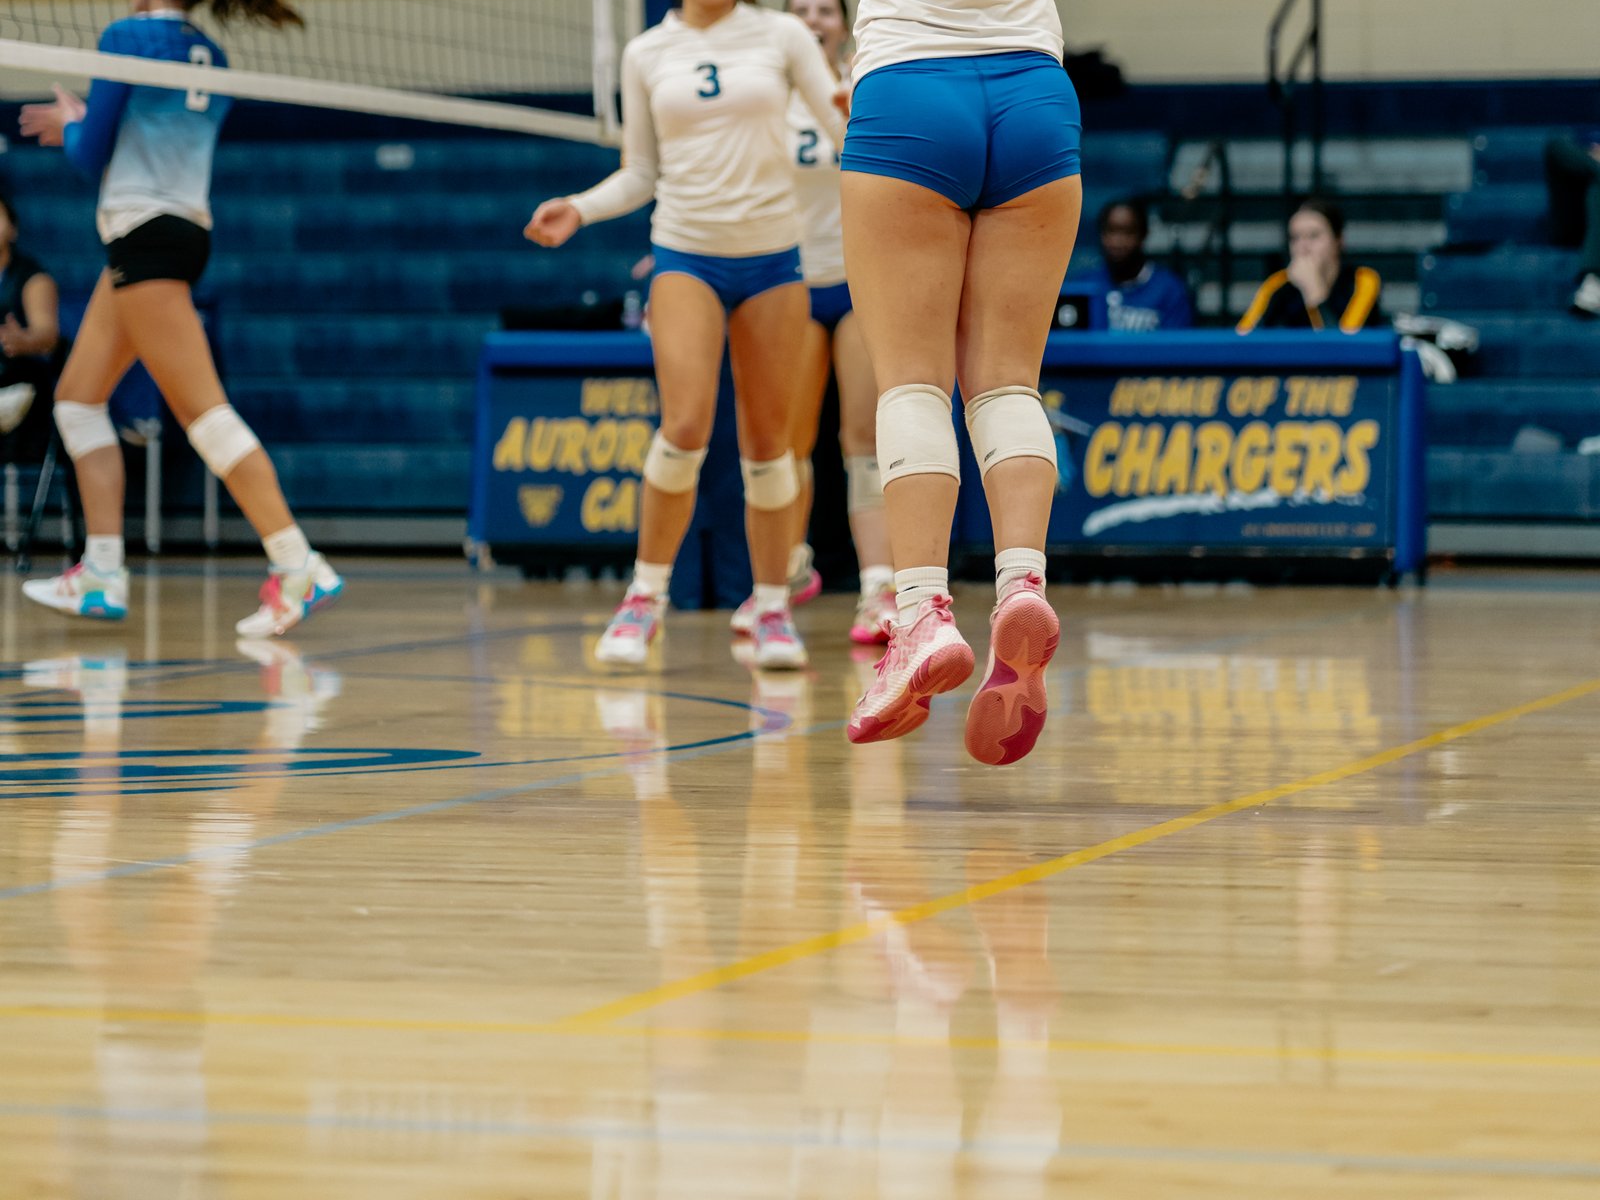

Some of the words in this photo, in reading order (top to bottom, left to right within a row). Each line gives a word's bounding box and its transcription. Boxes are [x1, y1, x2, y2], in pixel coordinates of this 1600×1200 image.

[696, 63, 721, 98] 3
[1109, 377, 1224, 417] HOME
[1226, 377, 1280, 417] OF
[1284, 376, 1358, 417] THE
[493, 416, 655, 477] AUROR
[1083, 420, 1380, 499] CHARGERS
[581, 476, 640, 533] CA
